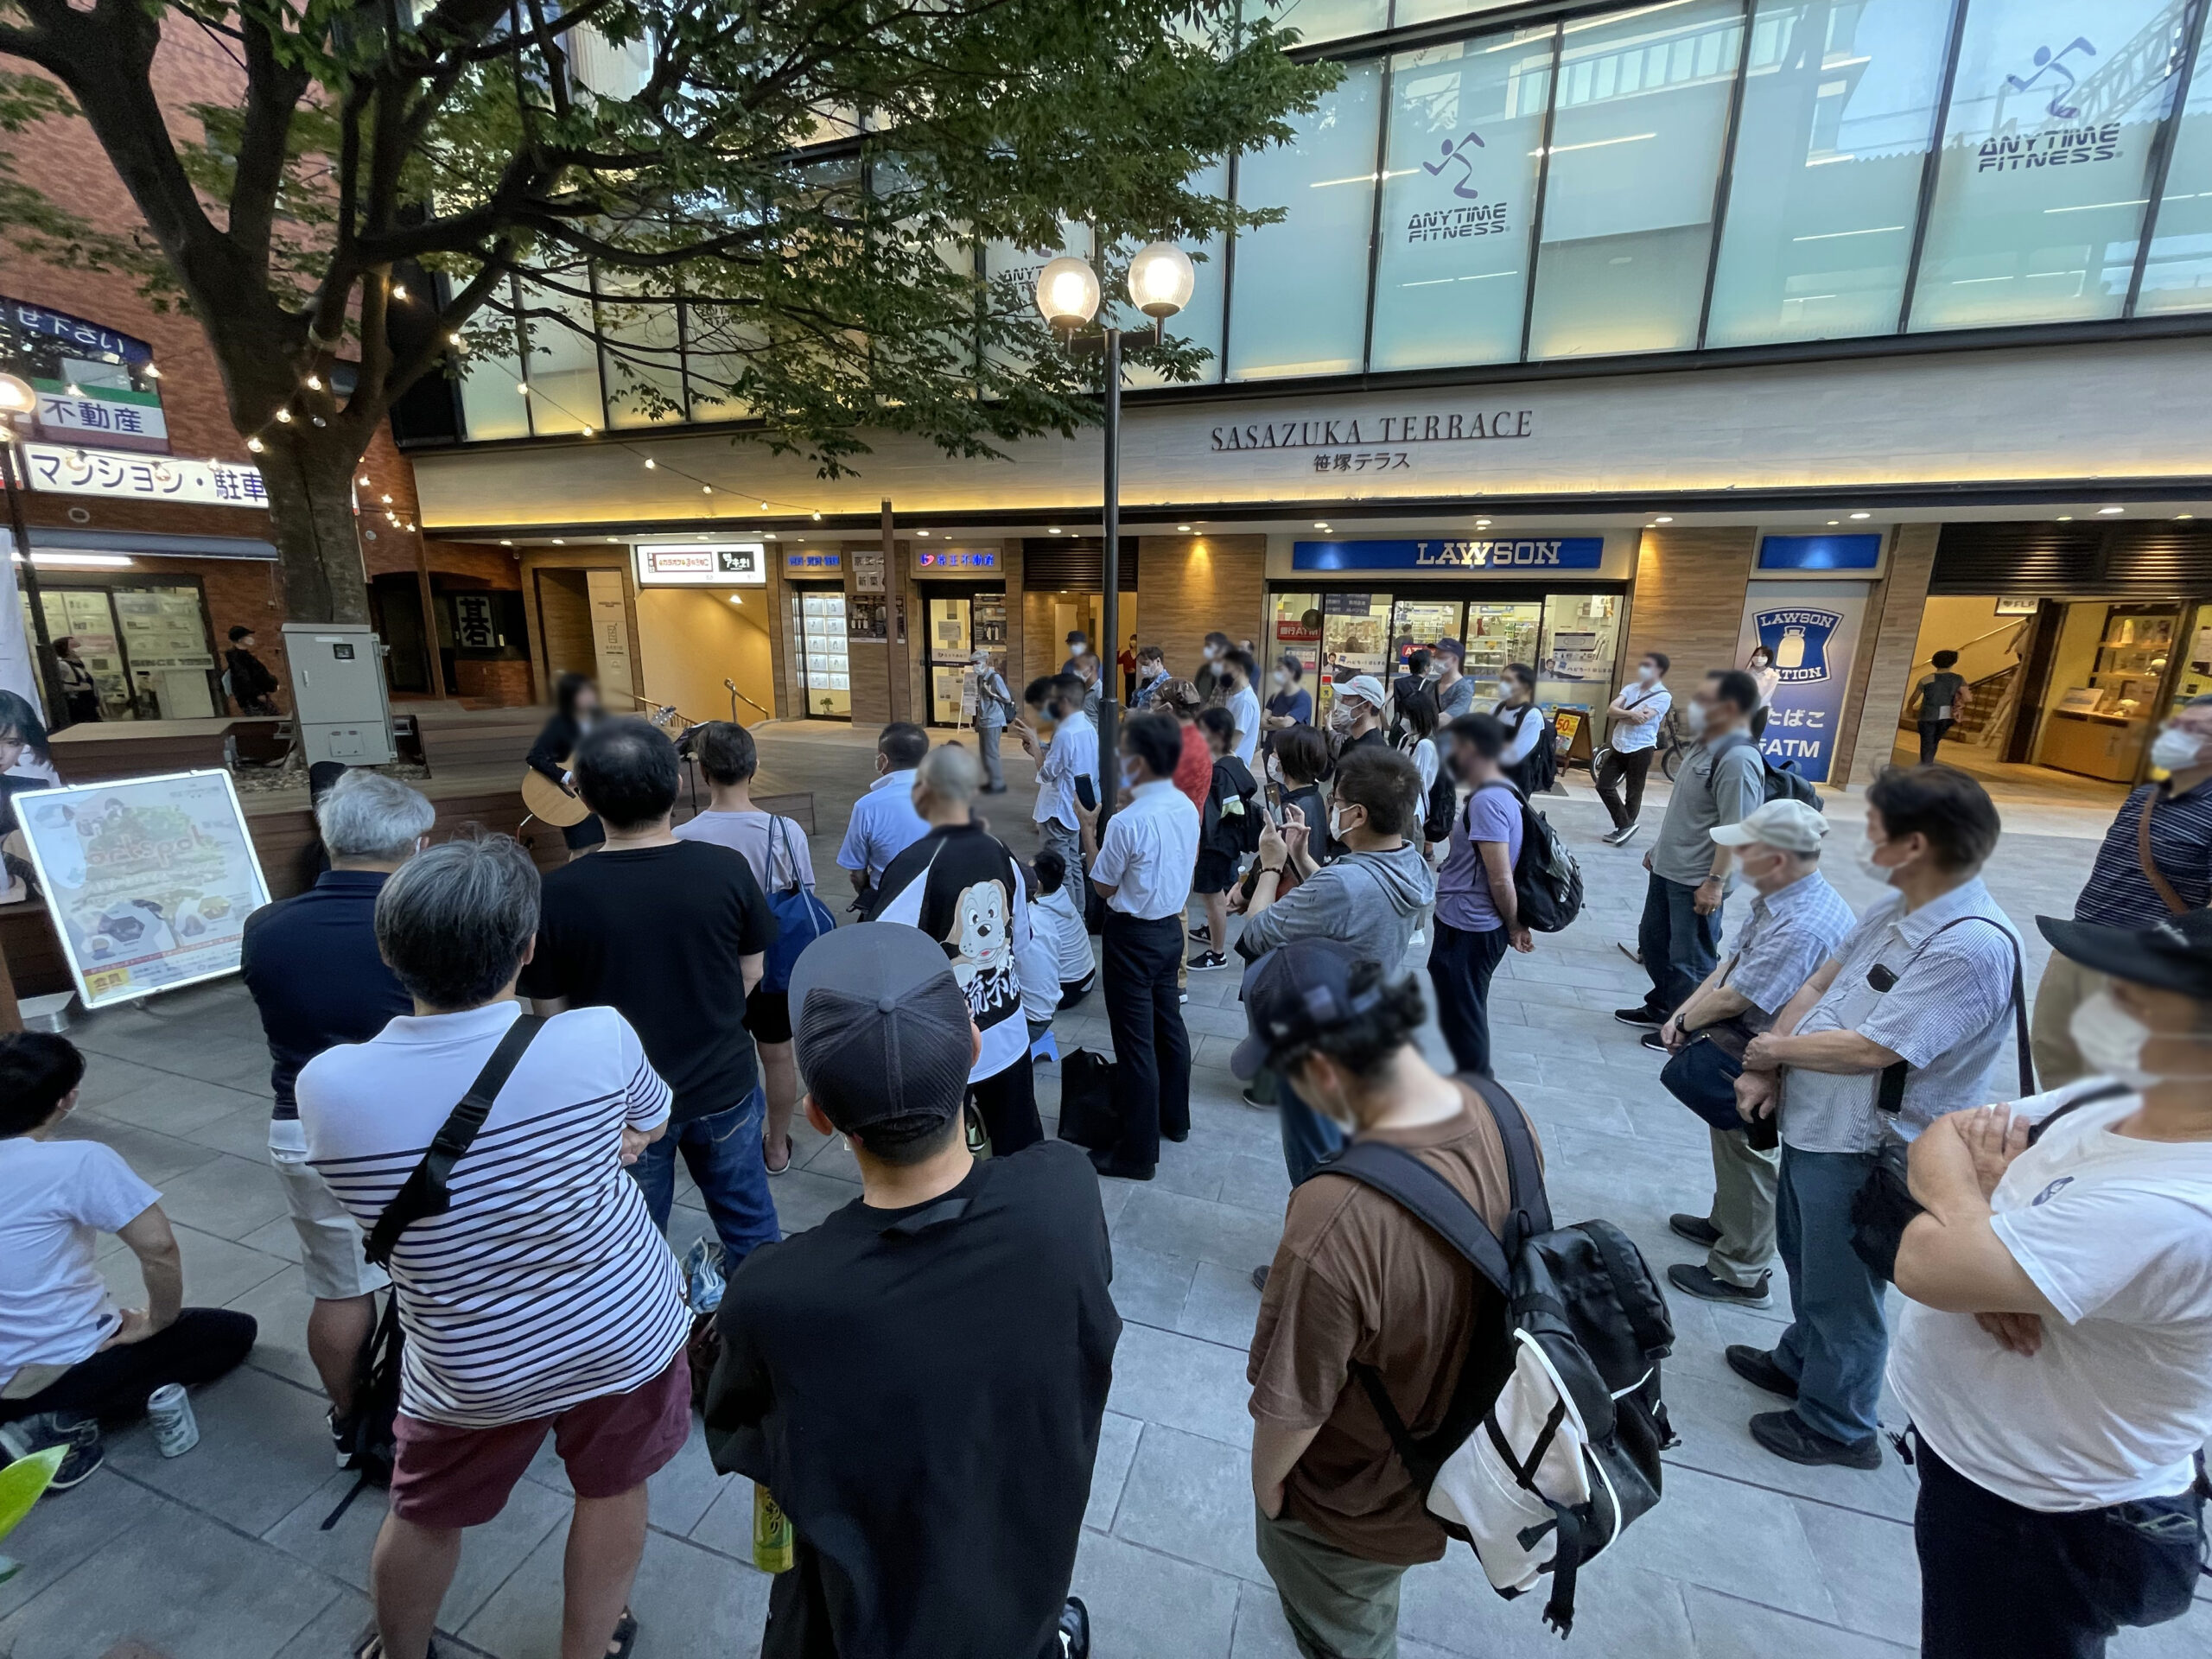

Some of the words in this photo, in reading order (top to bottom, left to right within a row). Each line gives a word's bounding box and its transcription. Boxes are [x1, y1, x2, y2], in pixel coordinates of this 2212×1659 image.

[1978, 122, 2120, 156] ANYTIME
[1978, 143, 2116, 173] FITNESS
[1408, 202, 1507, 229] ANYTIME
[1408, 219, 1505, 243] FITNESS
[0, 306, 124, 353] せ下さい
[41, 398, 143, 433] 不動産
[1211, 419, 1362, 451] SASAZUKA
[1379, 410, 1533, 442] TERRACE
[1313, 452, 1411, 473] 笹塚テラス
[1416, 541, 1562, 566] LAWSON
[1760, 612, 1834, 628] LAWSON
